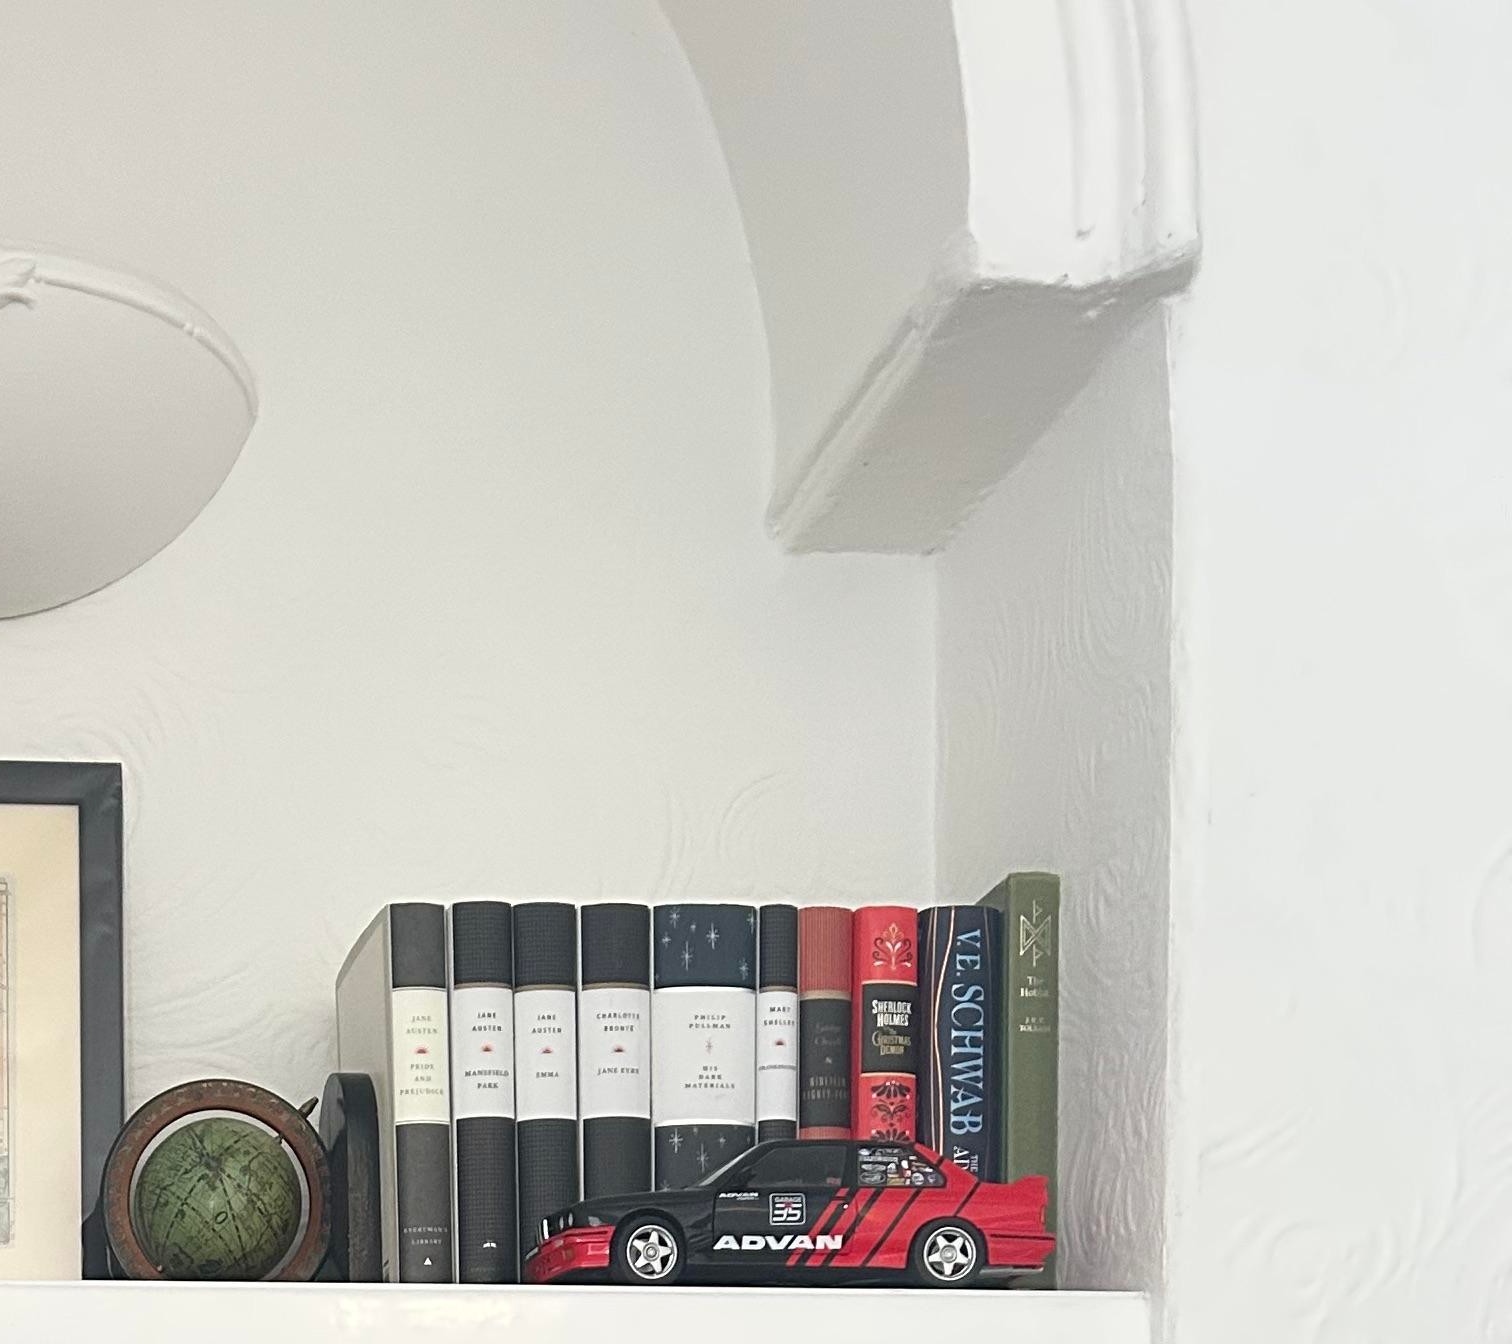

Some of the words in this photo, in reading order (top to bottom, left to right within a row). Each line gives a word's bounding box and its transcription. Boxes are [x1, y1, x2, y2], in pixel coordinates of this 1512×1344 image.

[872, 1000, 912, 1014] SHERLOCK
[877, 1012, 909, 1027] HOLMES
[950, 986, 984, 1135] SCHWAB
[713, 1235, 843, 1249] ADVAN
